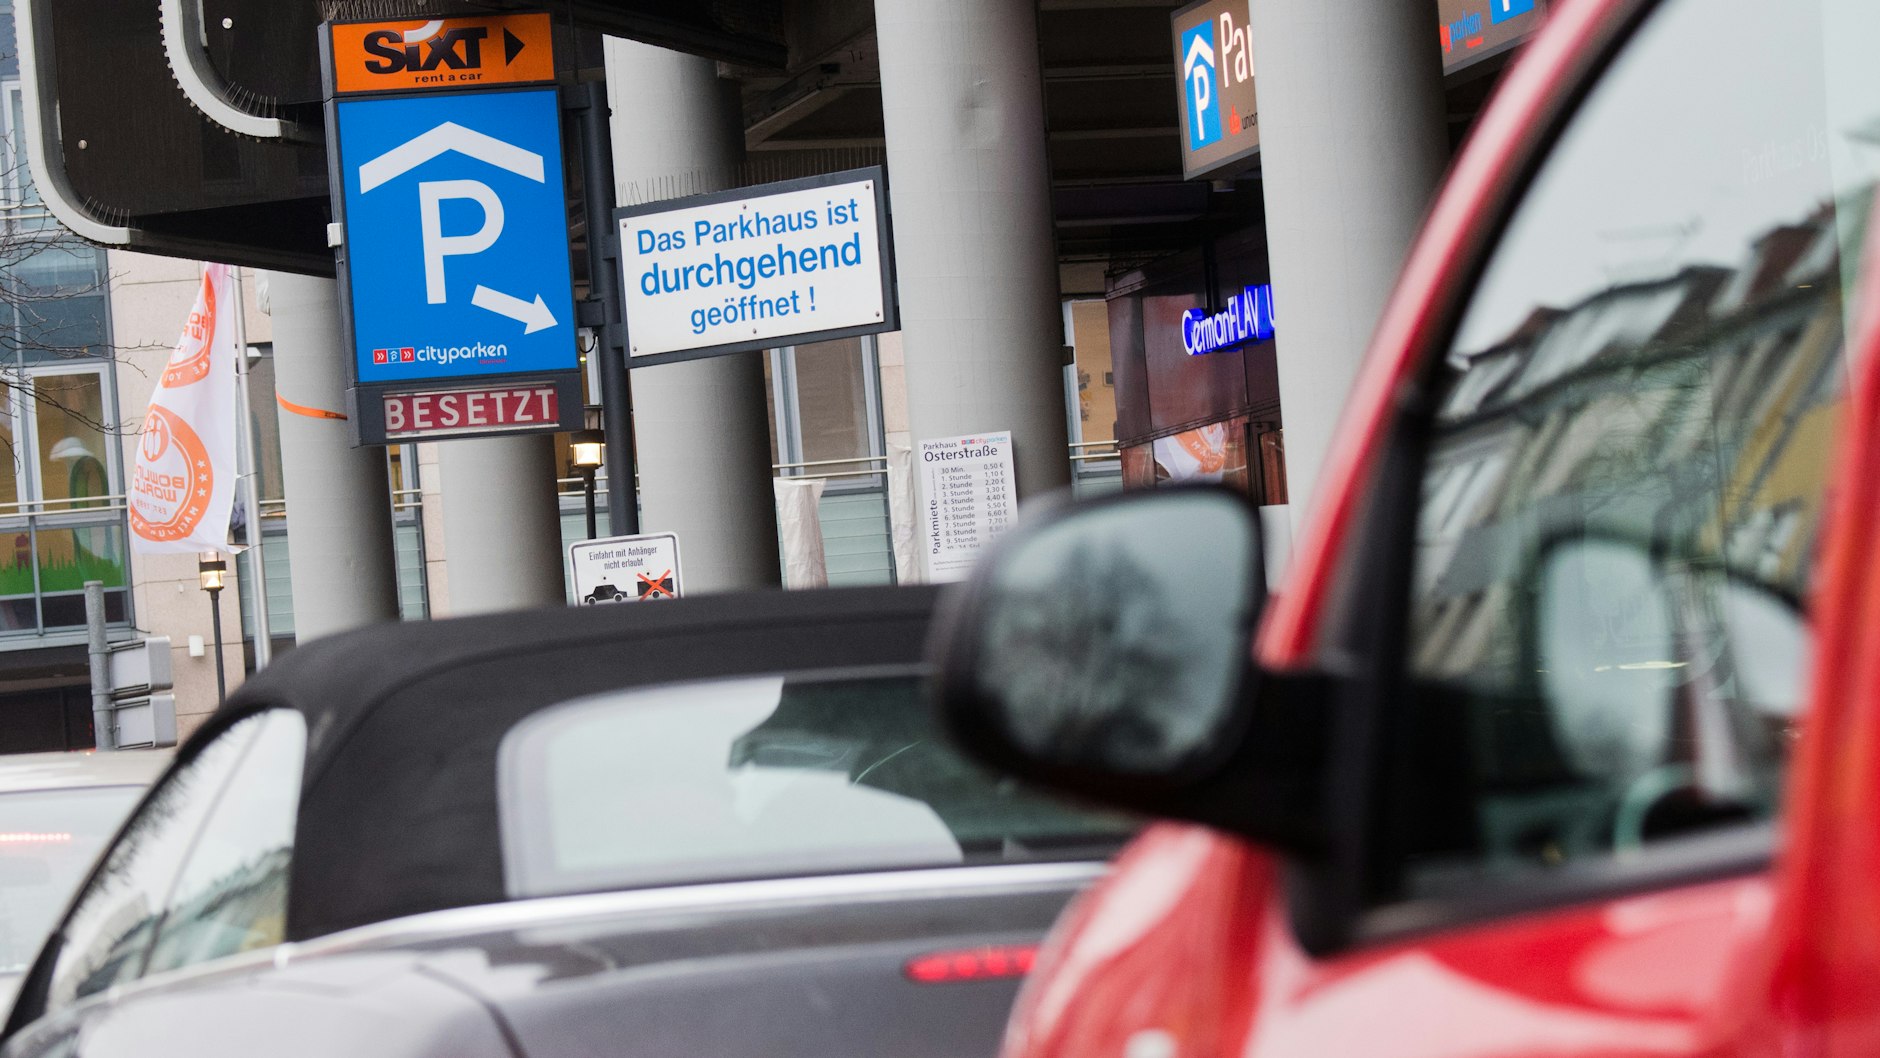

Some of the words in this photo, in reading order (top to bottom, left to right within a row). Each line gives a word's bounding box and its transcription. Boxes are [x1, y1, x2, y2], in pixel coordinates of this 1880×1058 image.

[414, 72, 444, 83] rent
[447, 73, 454, 82] a
[459, 72, 483, 81] car
[638, 228, 686, 255] Das
[695, 210, 818, 247] Parkhaus
[827, 198, 859, 226] ist
[418, 180, 505, 304] P
[640, 234, 862, 296] durchgehend
[691, 294, 800, 336] geöffnet
[810, 286, 817, 311] !
[417, 342, 507, 364] cityparken
[385, 389, 555, 431] BESETZT
[923, 441, 957, 450] Parkhaus
[924, 445, 998, 462] Osterstraße
[985, 470, 998, 478] 1,10
[985, 478, 999, 486] 2,20
[986, 486, 1000, 494] 3,30
[987, 502, 1001, 510] 5,50
[930, 499, 941, 554] Parkmiete
[589, 550, 614, 560] Einfahrt
[616, 548, 626, 557] mit
[628, 547, 657, 556] Anhänger
[604, 561, 620, 570] nicht
[621, 558, 643, 568] erlaubt
